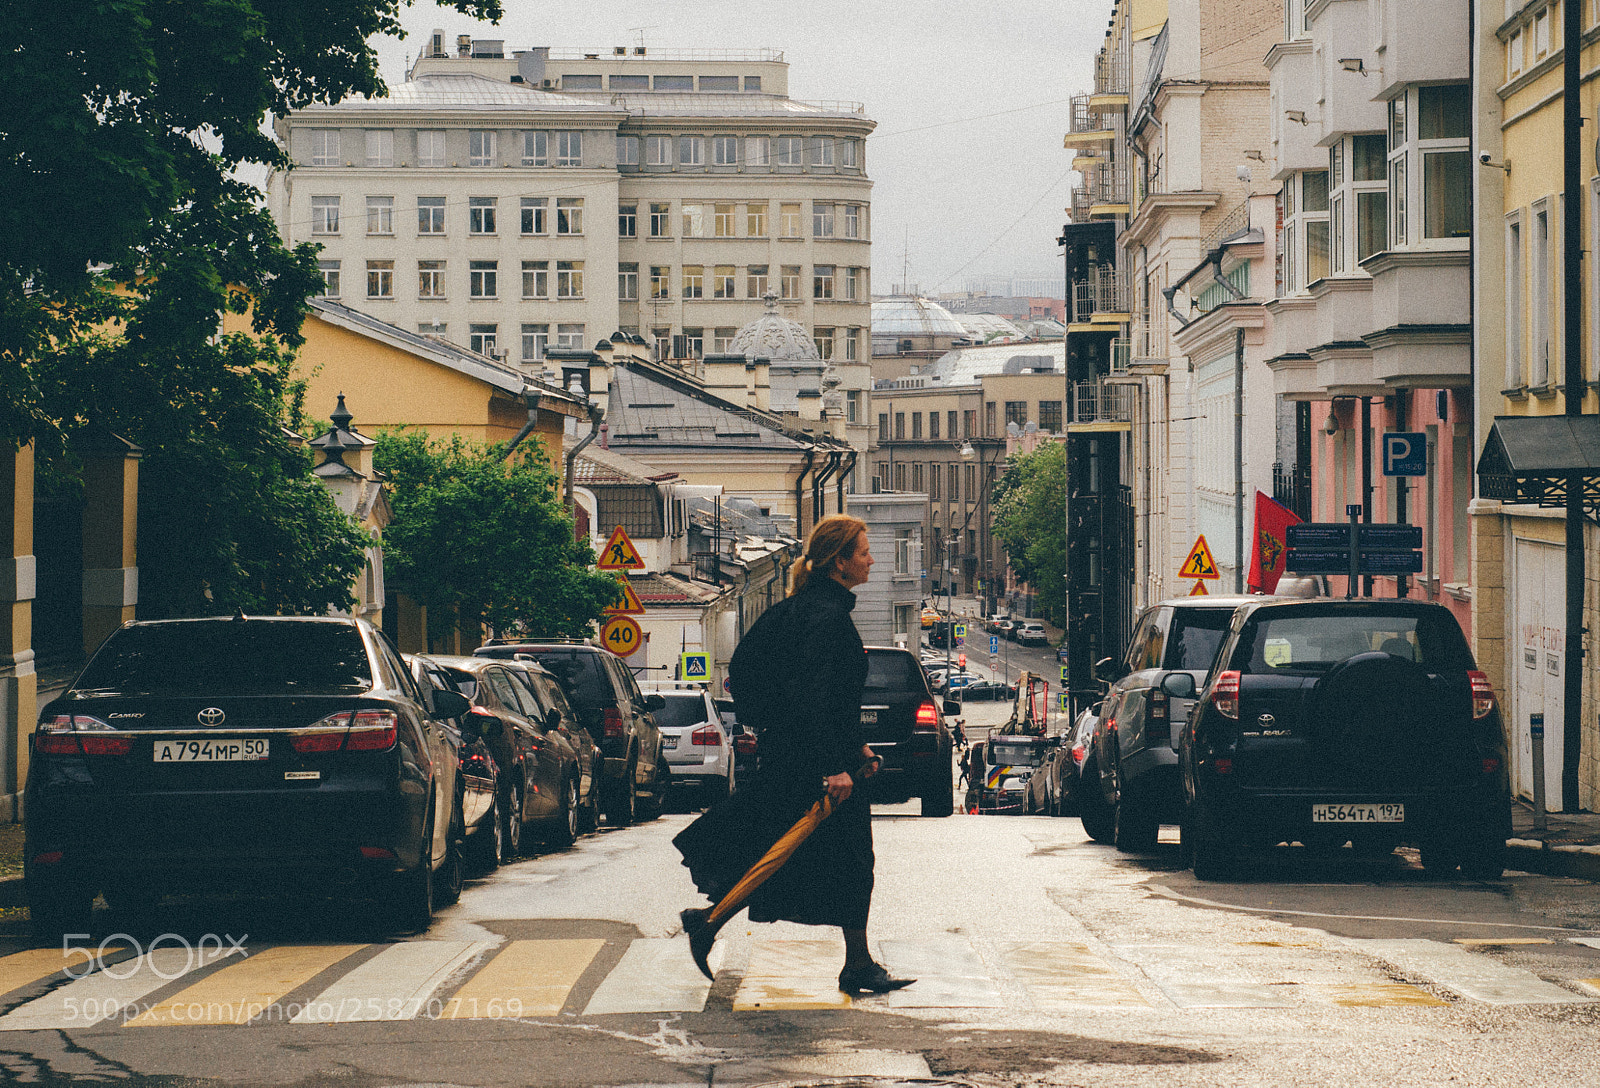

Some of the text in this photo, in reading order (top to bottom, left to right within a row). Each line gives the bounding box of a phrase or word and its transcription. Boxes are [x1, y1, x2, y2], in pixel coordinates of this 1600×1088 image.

[1387, 437, 1411, 471] P
[608, 627, 633, 643] 40
[245, 740, 265, 754] 50
[1379, 804, 1400, 816] 197
